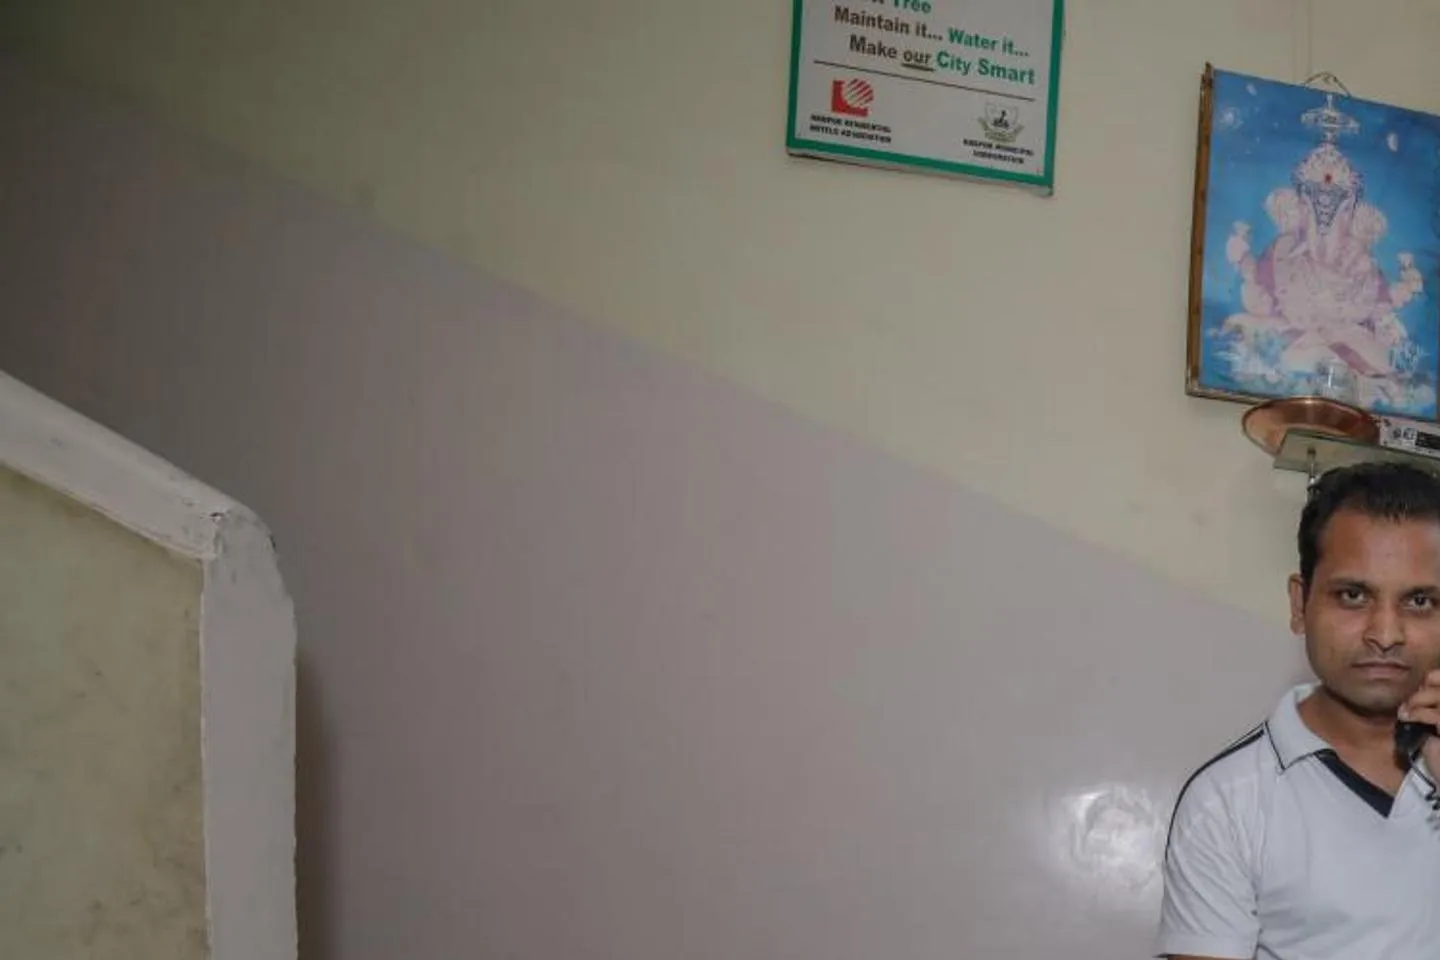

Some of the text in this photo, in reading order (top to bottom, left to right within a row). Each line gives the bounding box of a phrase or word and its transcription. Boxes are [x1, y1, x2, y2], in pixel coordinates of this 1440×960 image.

[834, 5, 1029, 58] Maintain it... Water it...
[850, 34, 1035, 86] Make our City Smart
